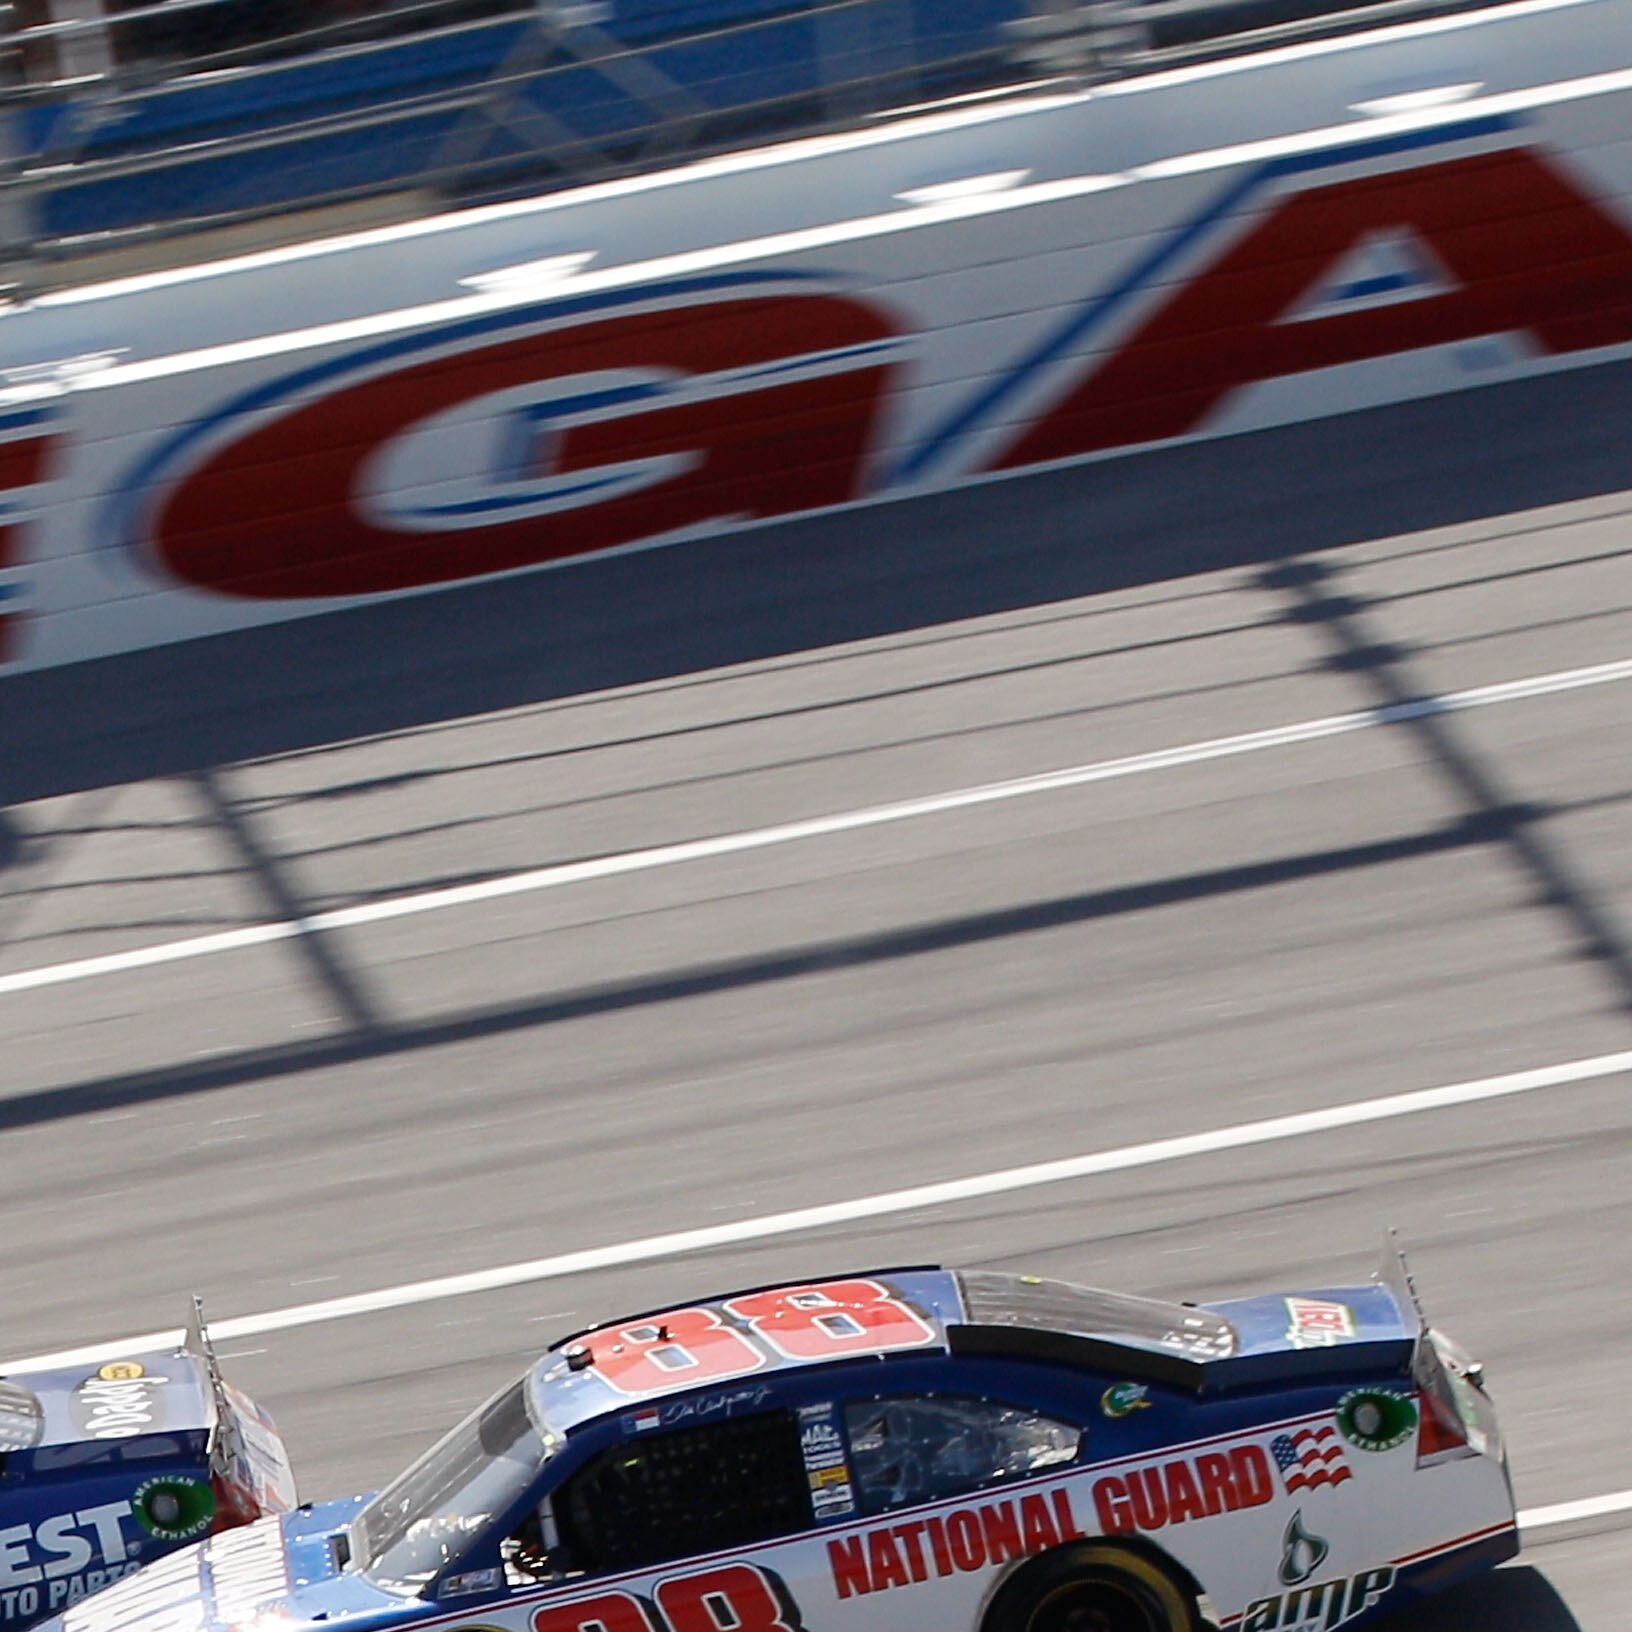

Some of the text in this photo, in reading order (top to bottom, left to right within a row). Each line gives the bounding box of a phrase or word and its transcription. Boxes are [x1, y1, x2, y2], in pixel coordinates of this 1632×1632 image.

[560, 1277, 938, 1396] 88
[1336, 1386, 1408, 1414] AMERICAN
[135, 1474, 195, 1507] AMERICAN
[151, 1513, 214, 1541] ETHANOL
[826, 1444, 1274, 1599] NATIONAL GUARD
